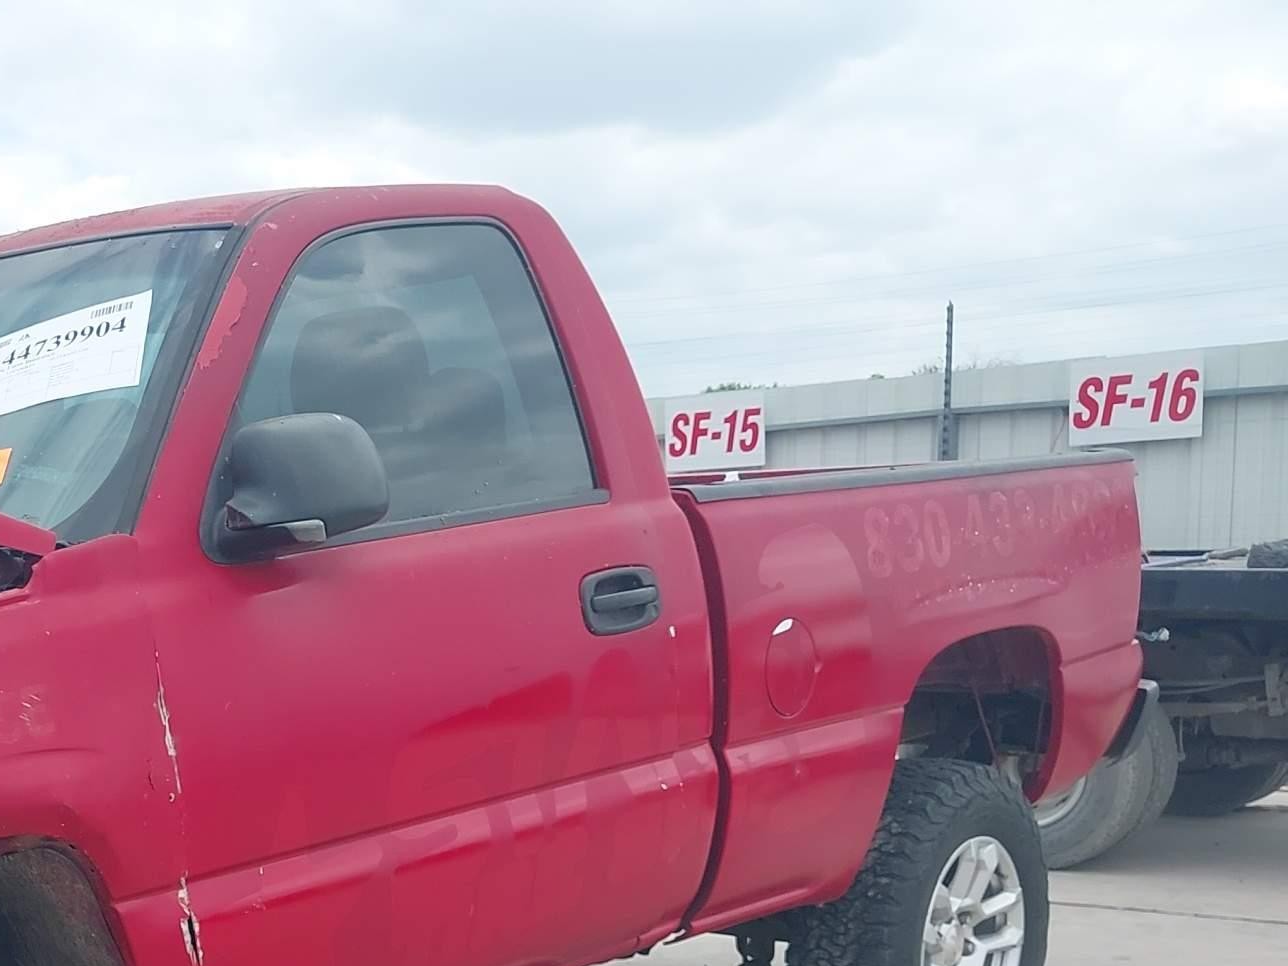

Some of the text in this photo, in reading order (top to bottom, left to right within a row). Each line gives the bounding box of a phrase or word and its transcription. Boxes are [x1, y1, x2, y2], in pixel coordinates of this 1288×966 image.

[2, 317, 127, 366] 44739904
[1072, 368, 1200, 429] SF-16
[668, 407, 760, 458] SF-15
